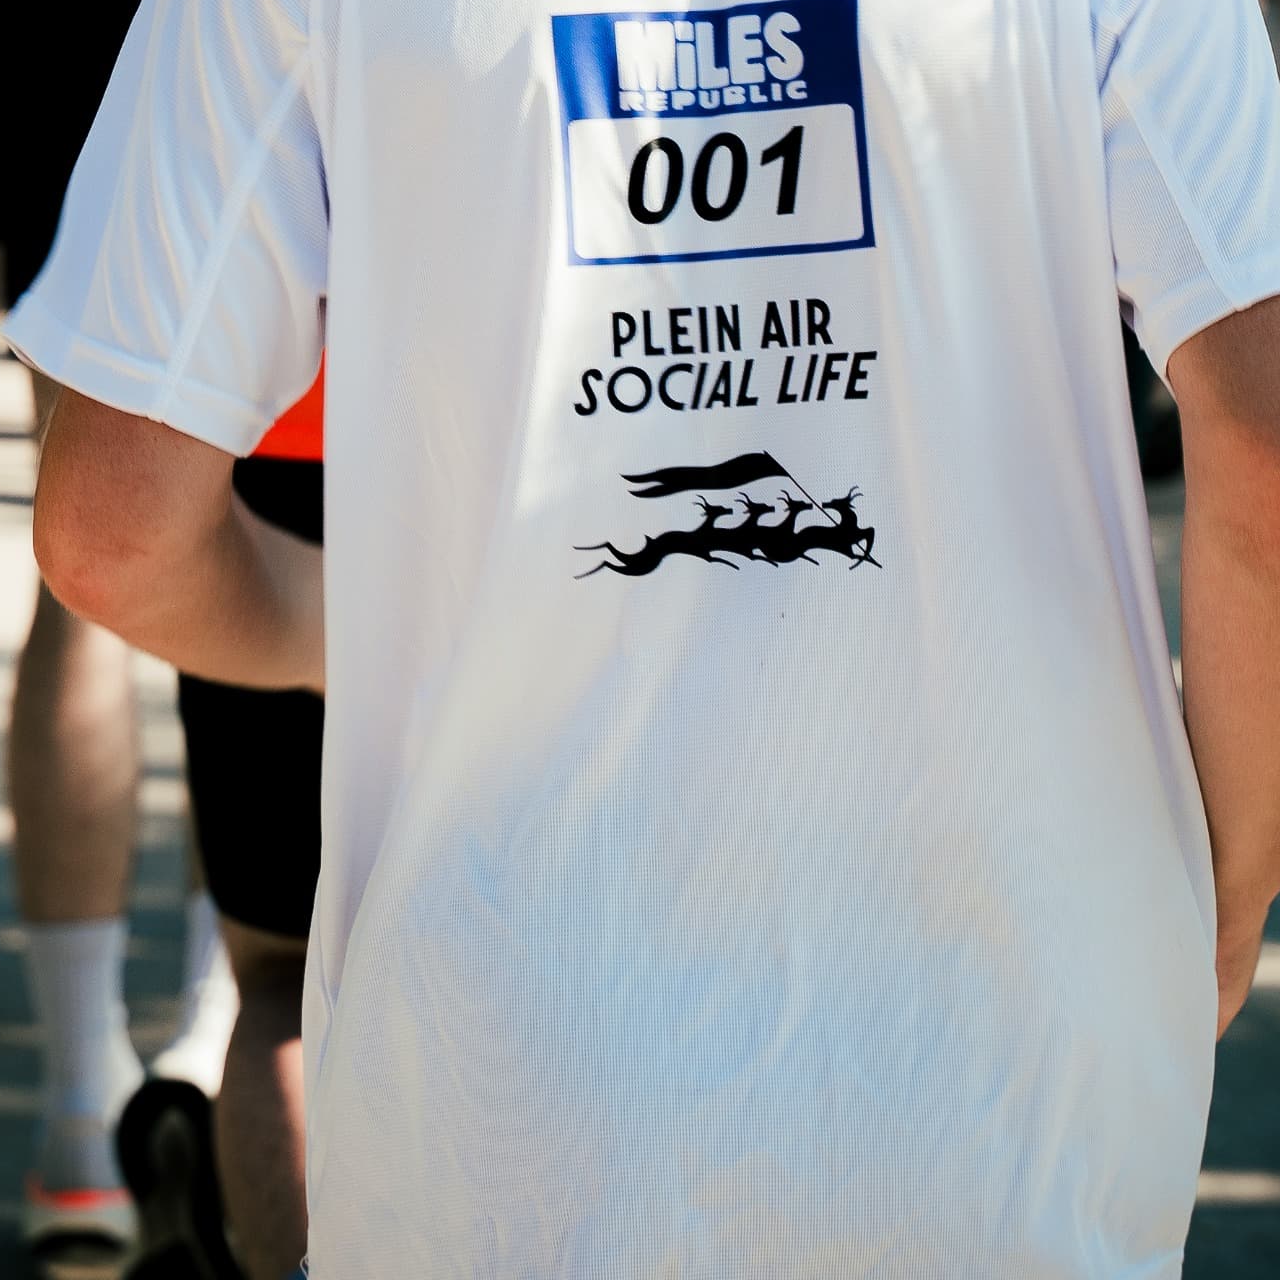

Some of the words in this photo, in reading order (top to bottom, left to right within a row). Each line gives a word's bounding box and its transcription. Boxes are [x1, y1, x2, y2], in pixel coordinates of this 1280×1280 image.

[619, 80, 808, 111] REPUBLIC
[627, 125, 805, 225] 001
[612, 304, 741, 357] PLEIN
[761, 298, 834, 349] AIR
[574, 358, 759, 416] SOCIAL
[777, 351, 878, 404] LIFE
